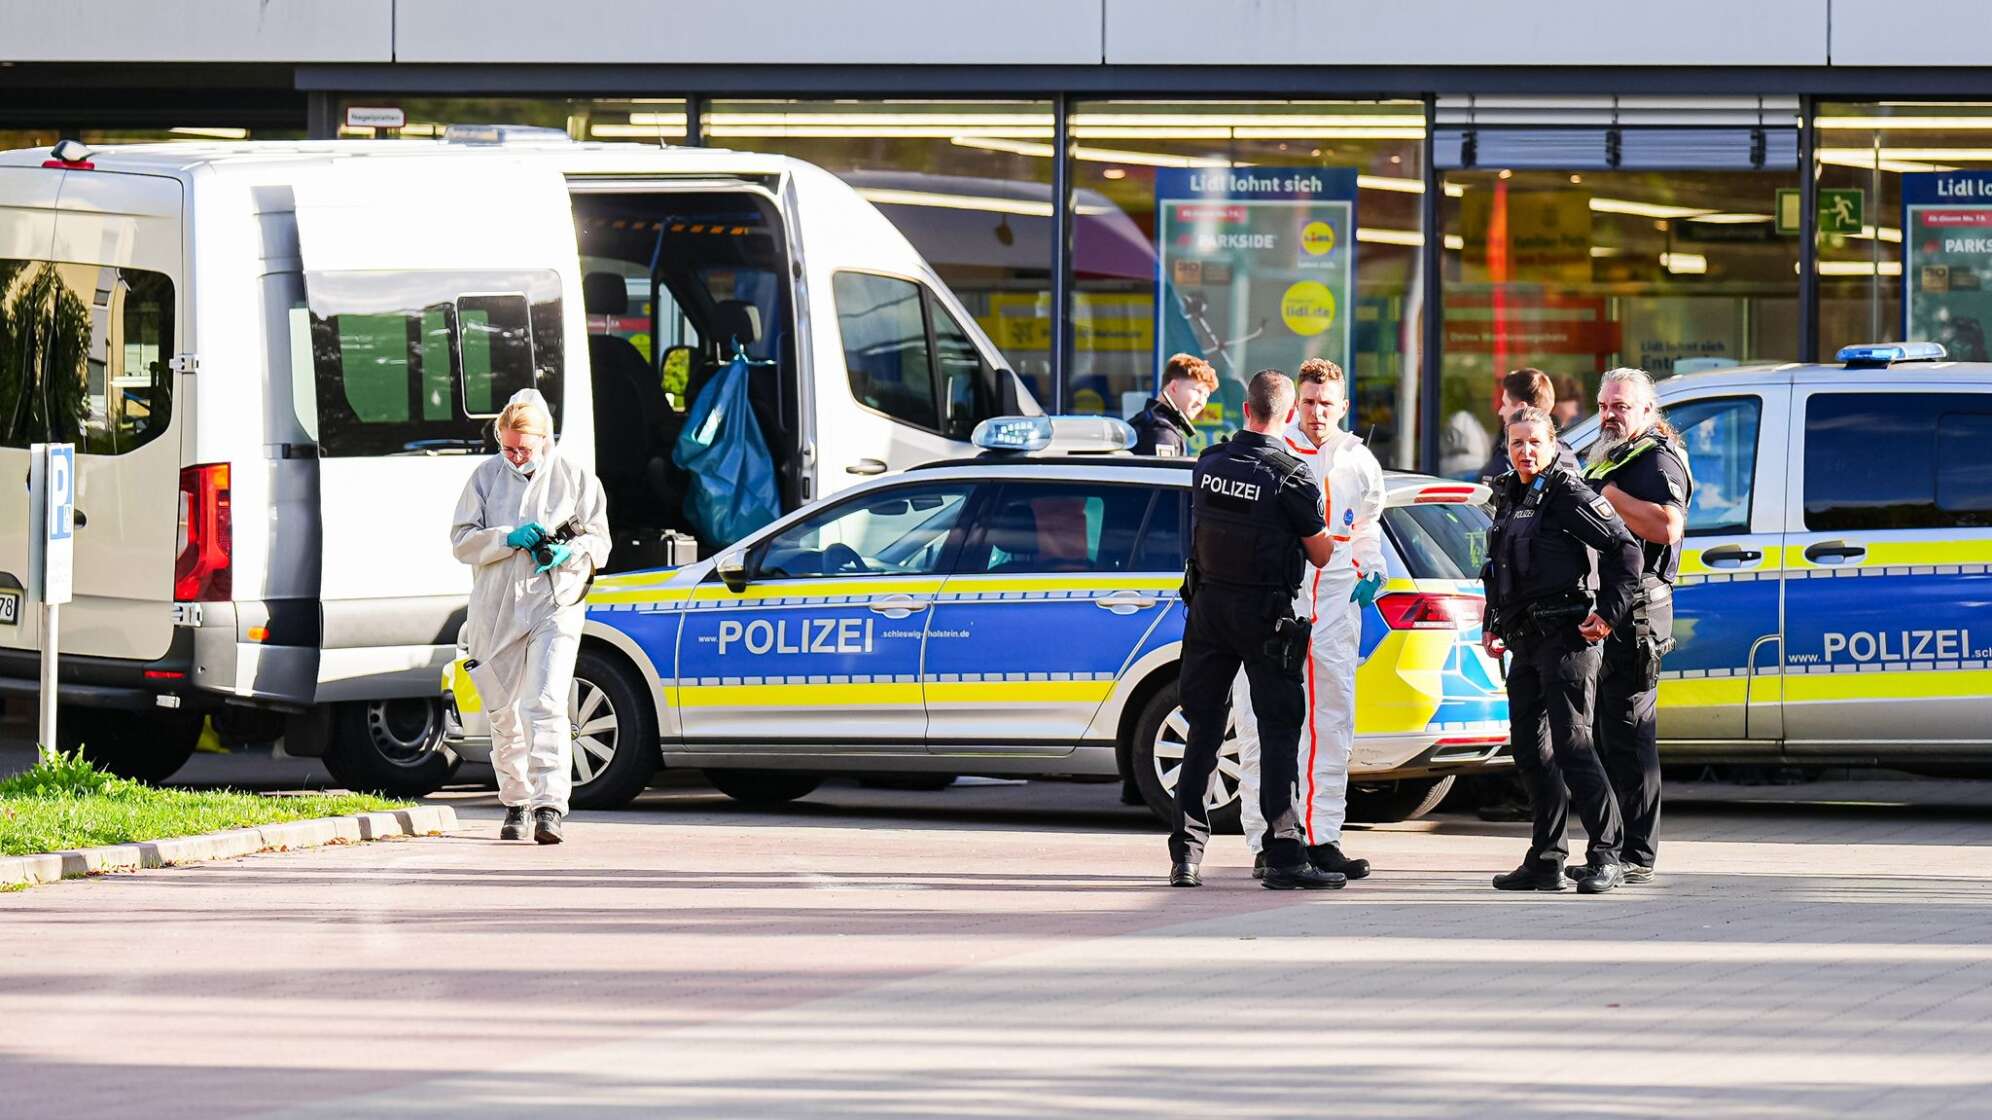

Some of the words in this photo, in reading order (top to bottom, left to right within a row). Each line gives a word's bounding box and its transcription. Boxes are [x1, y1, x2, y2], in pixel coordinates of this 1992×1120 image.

[1189, 175, 1226, 192] Lidl
[1230, 175, 1280, 192] lohnt
[1284, 175, 1323, 193] sich
[1937, 179, 1974, 196] Lidl
[1198, 234, 1275, 249] PARKSIDE
[52, 454, 69, 536] P
[1200, 473, 1261, 501] POLIZEI
[1513, 509, 1535, 520] POLIZEI
[718, 618, 874, 655] POLIZEI
[1824, 629, 1970, 662] POLIZEI
